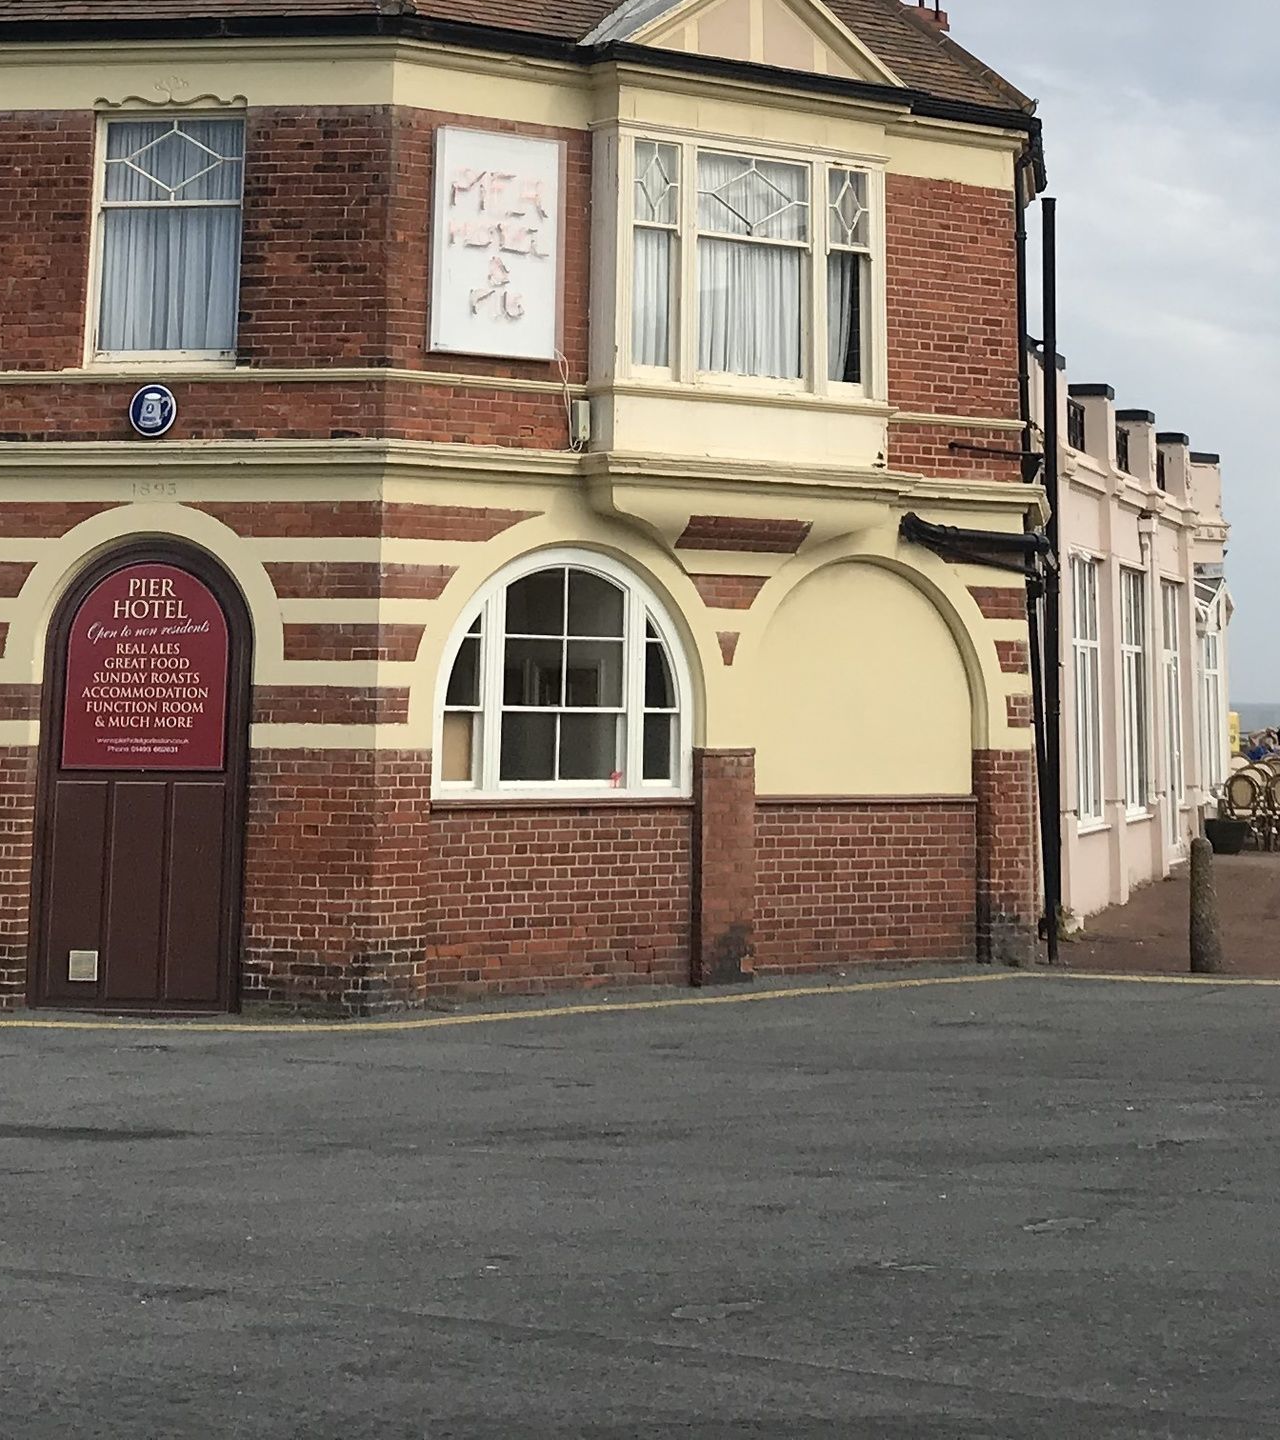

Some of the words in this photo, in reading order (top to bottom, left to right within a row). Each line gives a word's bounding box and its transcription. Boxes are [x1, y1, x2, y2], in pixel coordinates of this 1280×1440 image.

[129, 578, 176, 597] PIER
[113, 599, 189, 619] HOTEL
[87, 621, 118, 645] Open
[120, 624, 132, 637] to
[135, 627, 158, 637] non
[161, 618, 210, 635] residents
[116, 643, 147, 655] REAL
[149, 643, 180, 655] ALES
[104, 657, 147, 669] GREAT
[151, 657, 190, 669] FOOD
[93, 672, 148, 684] SUNDAY
[151, 672, 200, 684] ROASTS
[81, 686, 209, 699] ACCOMMODATION
[86, 701, 158, 713] FUNCTION
[162, 701, 204, 714] ROOM
[94, 715, 105, 728] &
[108, 716, 150, 728] MUCH
[153, 716, 194, 728] MORE
